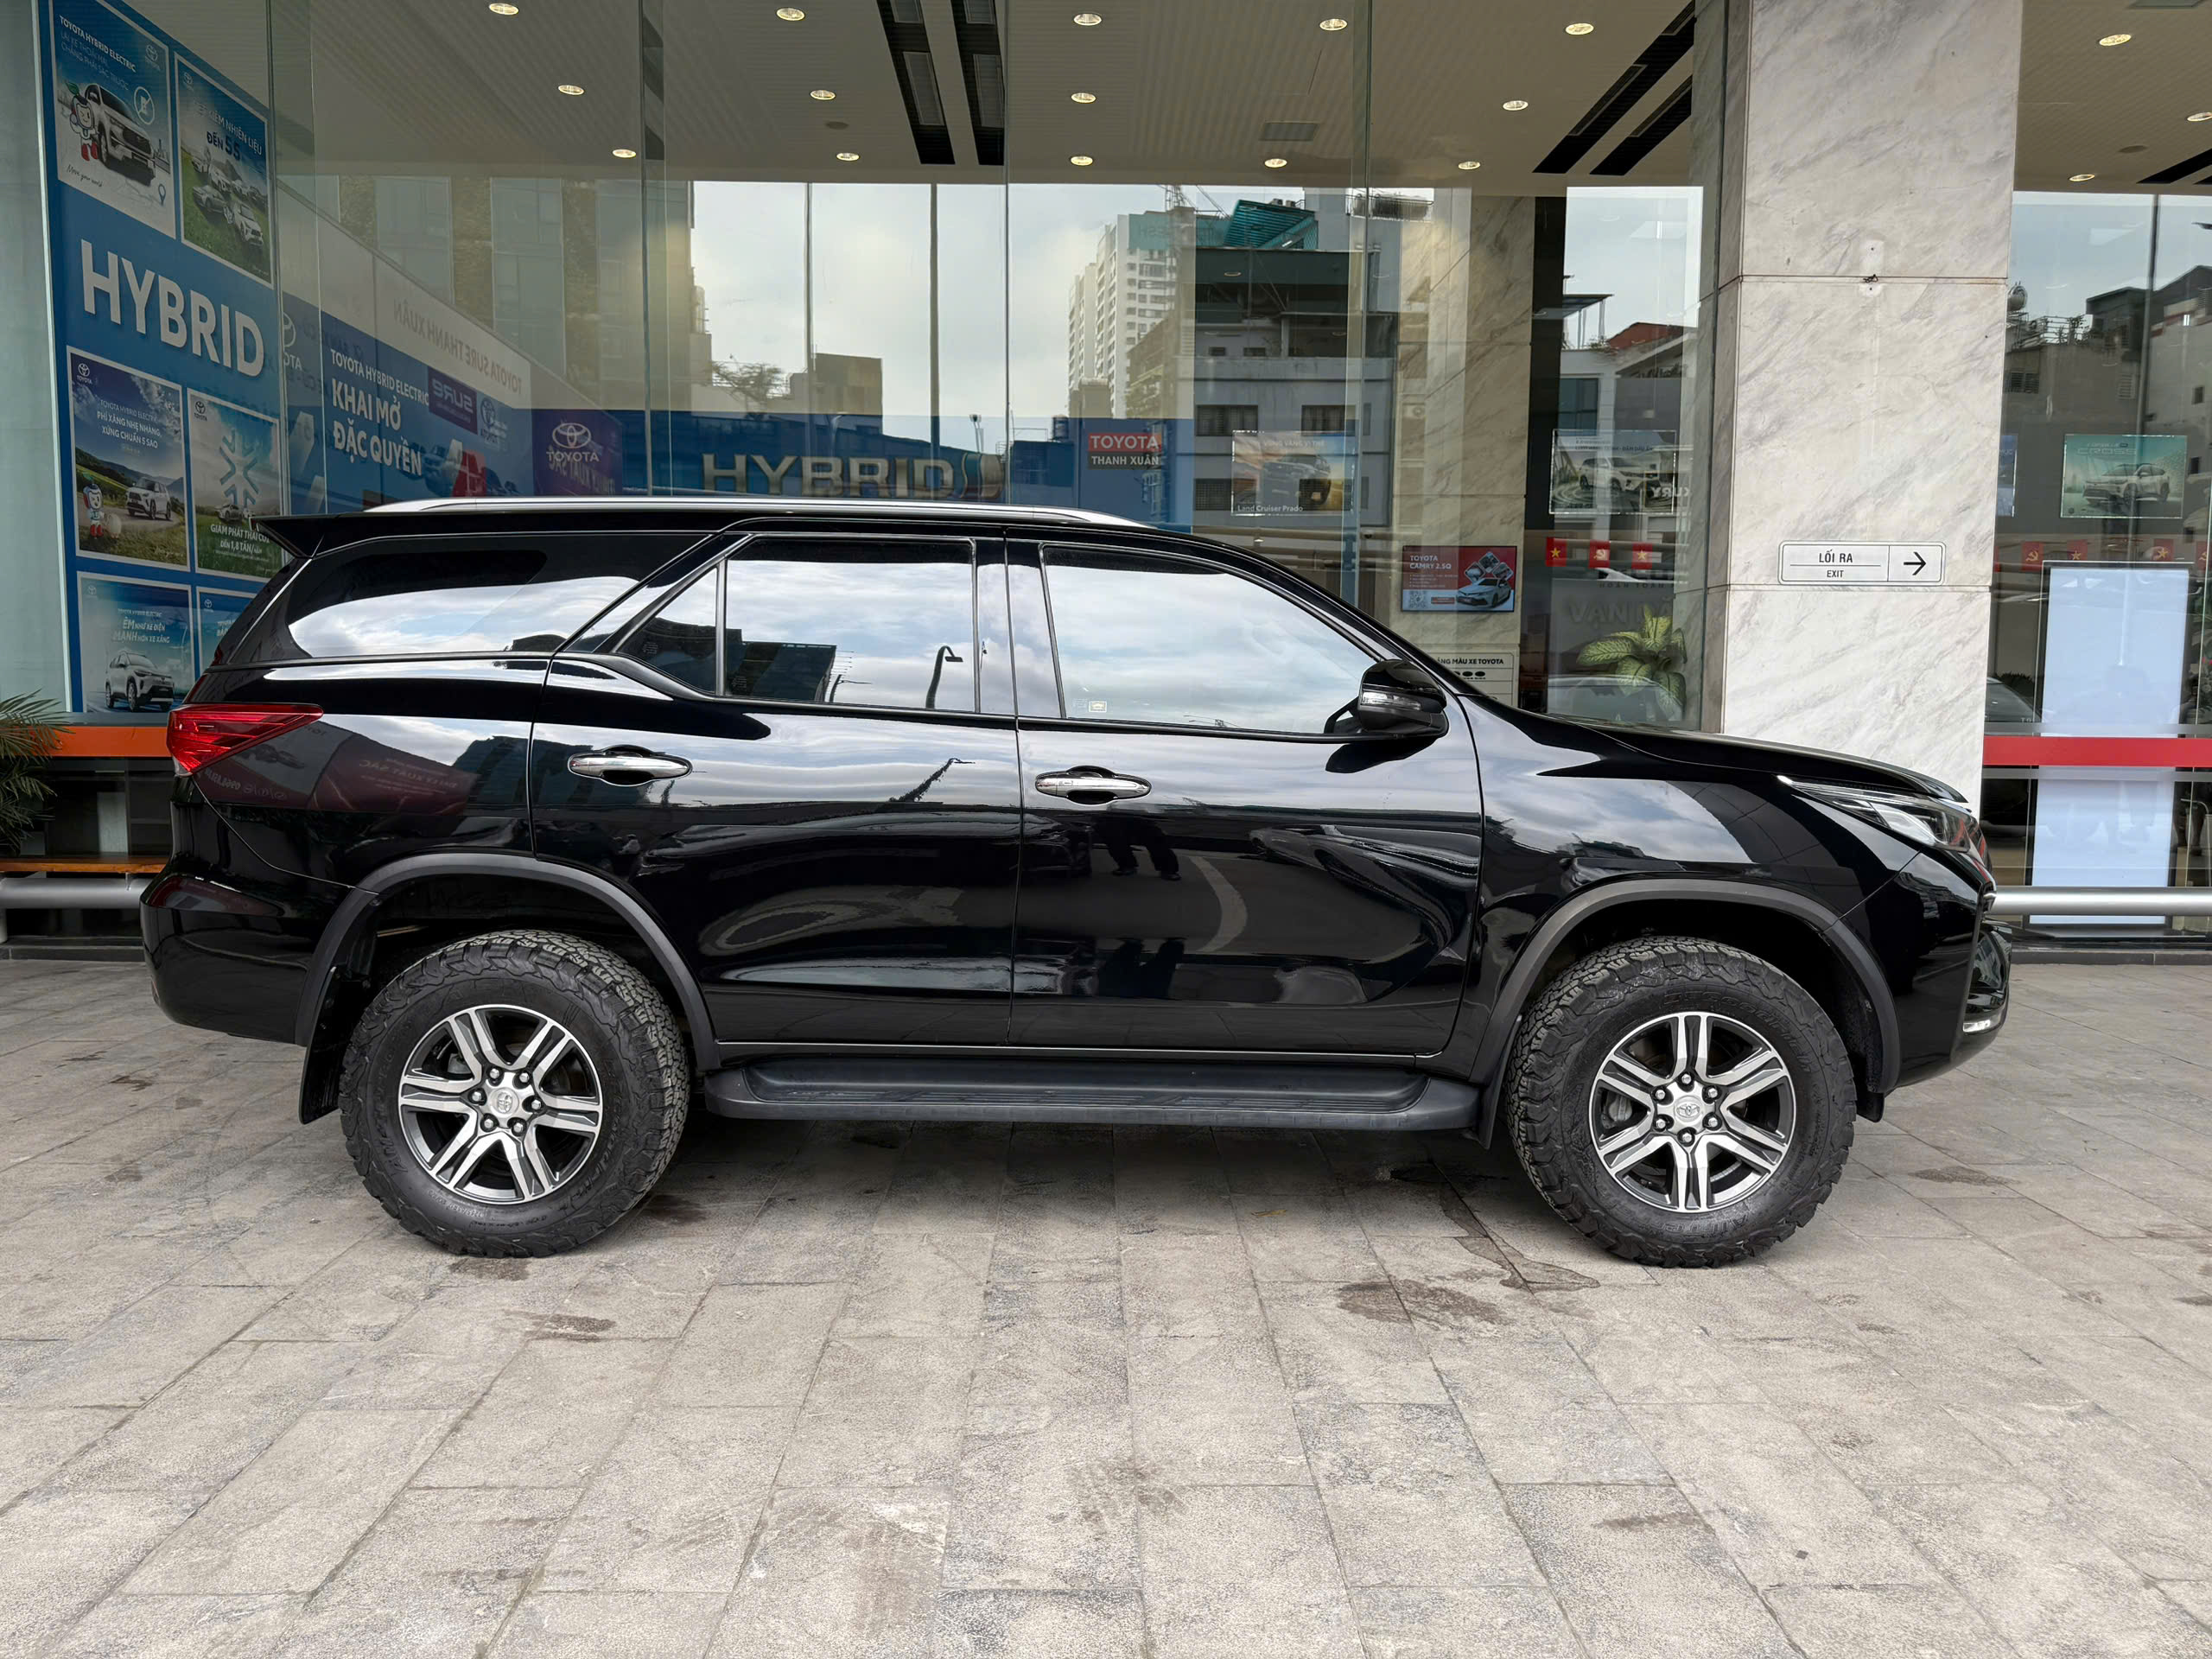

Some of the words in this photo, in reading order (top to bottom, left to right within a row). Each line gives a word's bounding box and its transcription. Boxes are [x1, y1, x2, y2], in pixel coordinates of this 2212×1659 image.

[60, 15, 85, 39] TOYOTA
[85, 32, 110, 54] HYBRID
[109, 49, 137, 73] ELECTRIC
[226, 119, 247, 144] NHIÊN
[248, 136, 263, 156] LIỆU
[81, 238, 264, 378] HYBRID
[330, 349, 364, 378] TOYOTA
[365, 365, 396, 391] HYBRID
[396, 380, 429, 406] ELECTRIC
[332, 378, 373, 421] KHAI
[376, 396, 401, 431] MỞ
[146, 438, 158, 448] SAO
[334, 417, 368, 463] ĐẶC
[370, 435, 423, 476] QUYỀN
[545, 451, 600, 462] TOYOTA
[1090, 435, 1159, 449] TOYOTA
[1091, 455, 1127, 465] THANH
[1129, 454, 1160, 465] XUÂN
[702, 453, 954, 498] HYBRID
[1819, 549, 1834, 563] LỐI
[1839, 553, 1853, 563] RA
